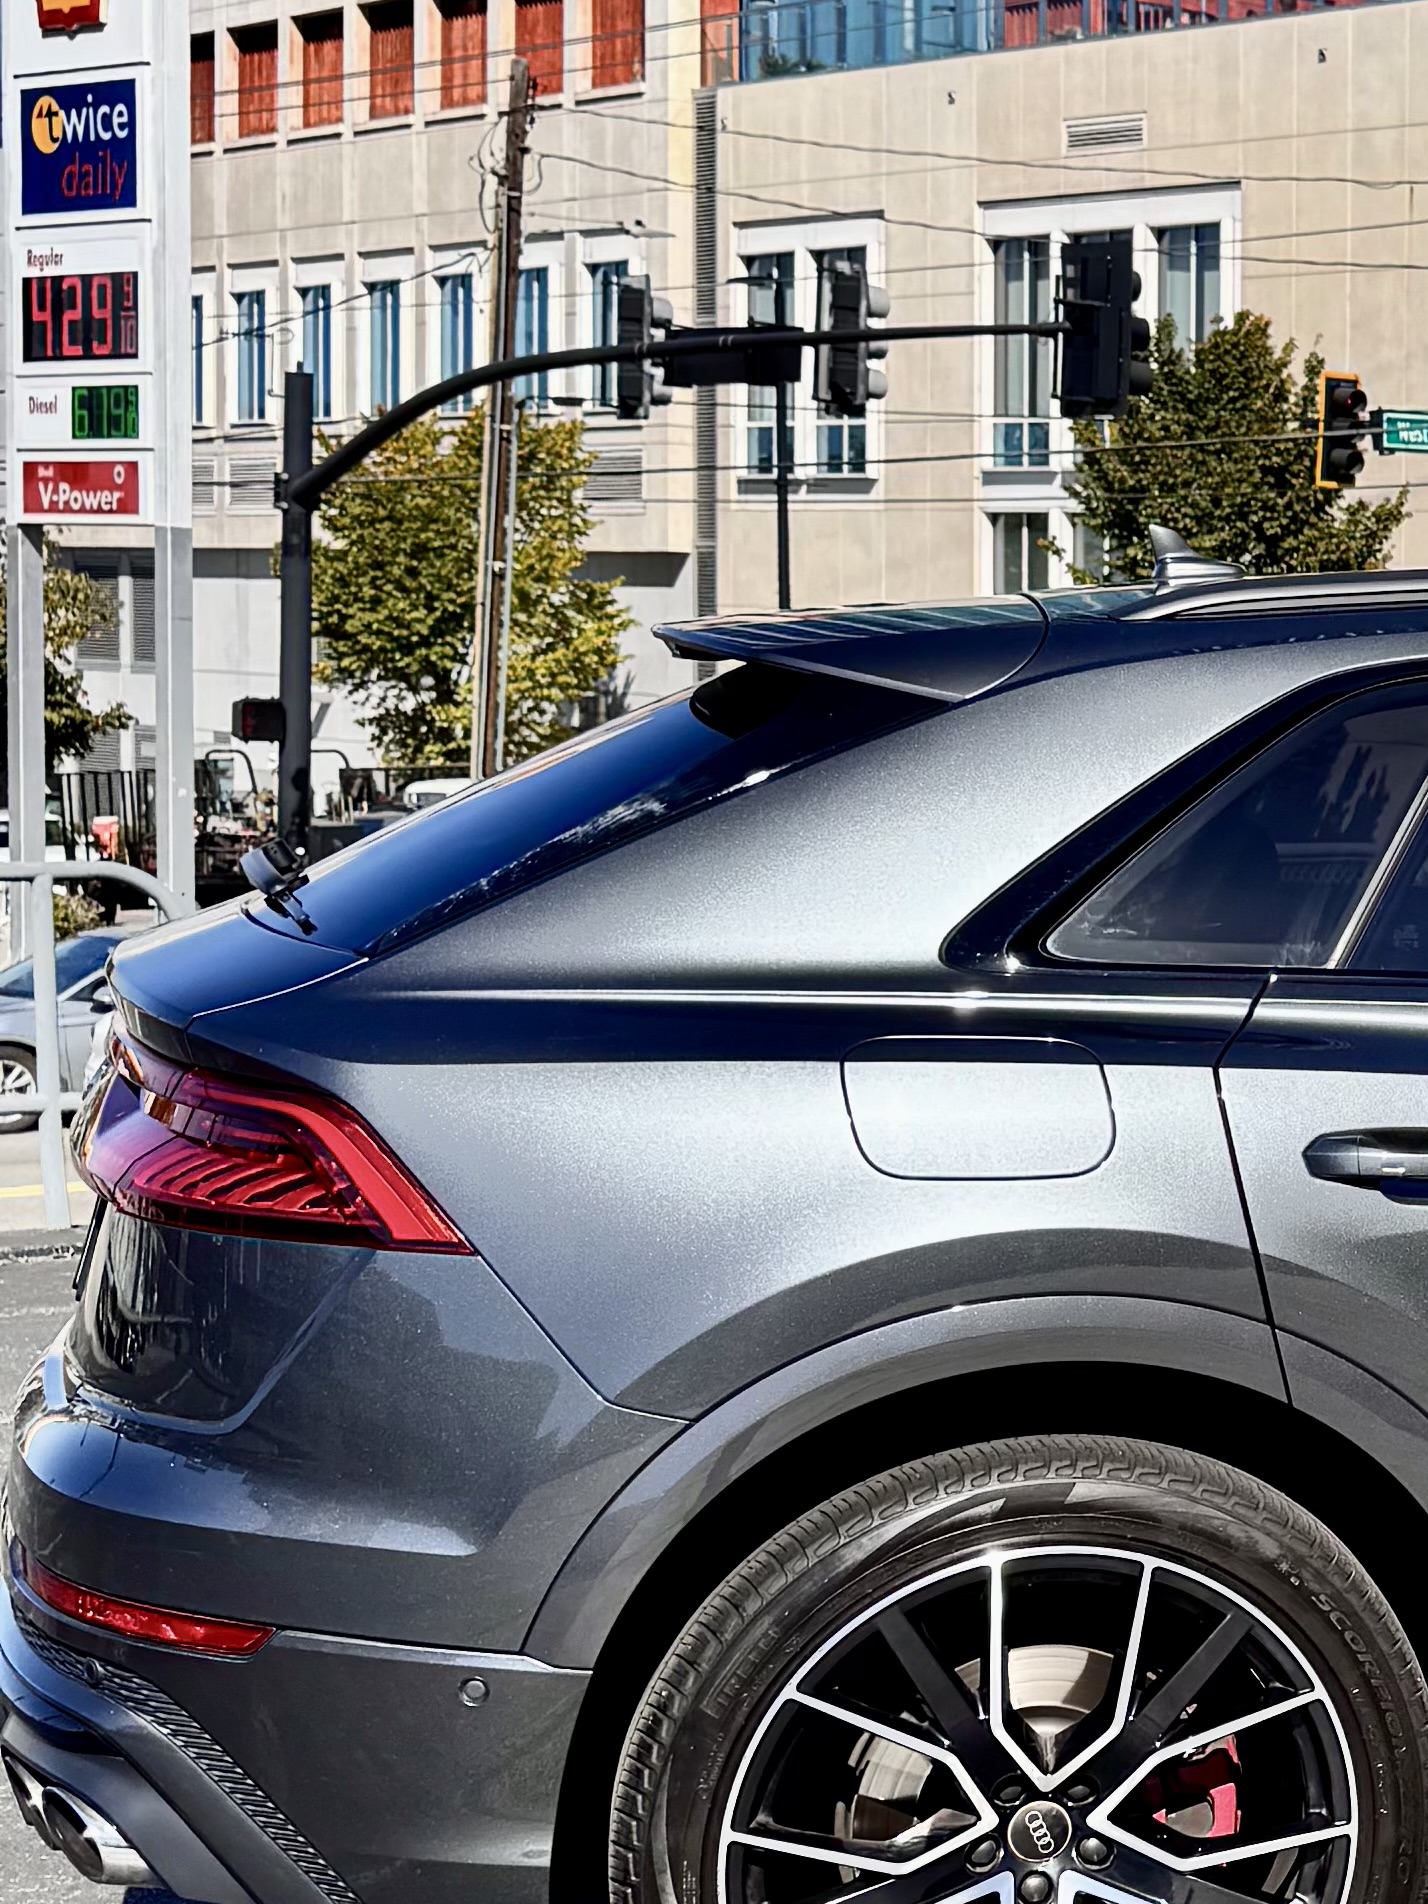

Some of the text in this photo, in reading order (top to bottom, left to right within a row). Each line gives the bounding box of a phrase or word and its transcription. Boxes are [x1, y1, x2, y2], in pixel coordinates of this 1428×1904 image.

[44, 93, 129, 144] twice
[61, 148, 128, 201] daily
[27, 247, 63, 272] Regular
[28, 394, 58, 414] Diesel
[1398, 427, 1428, 443] West
[38, 481, 119, 511] V-Power
